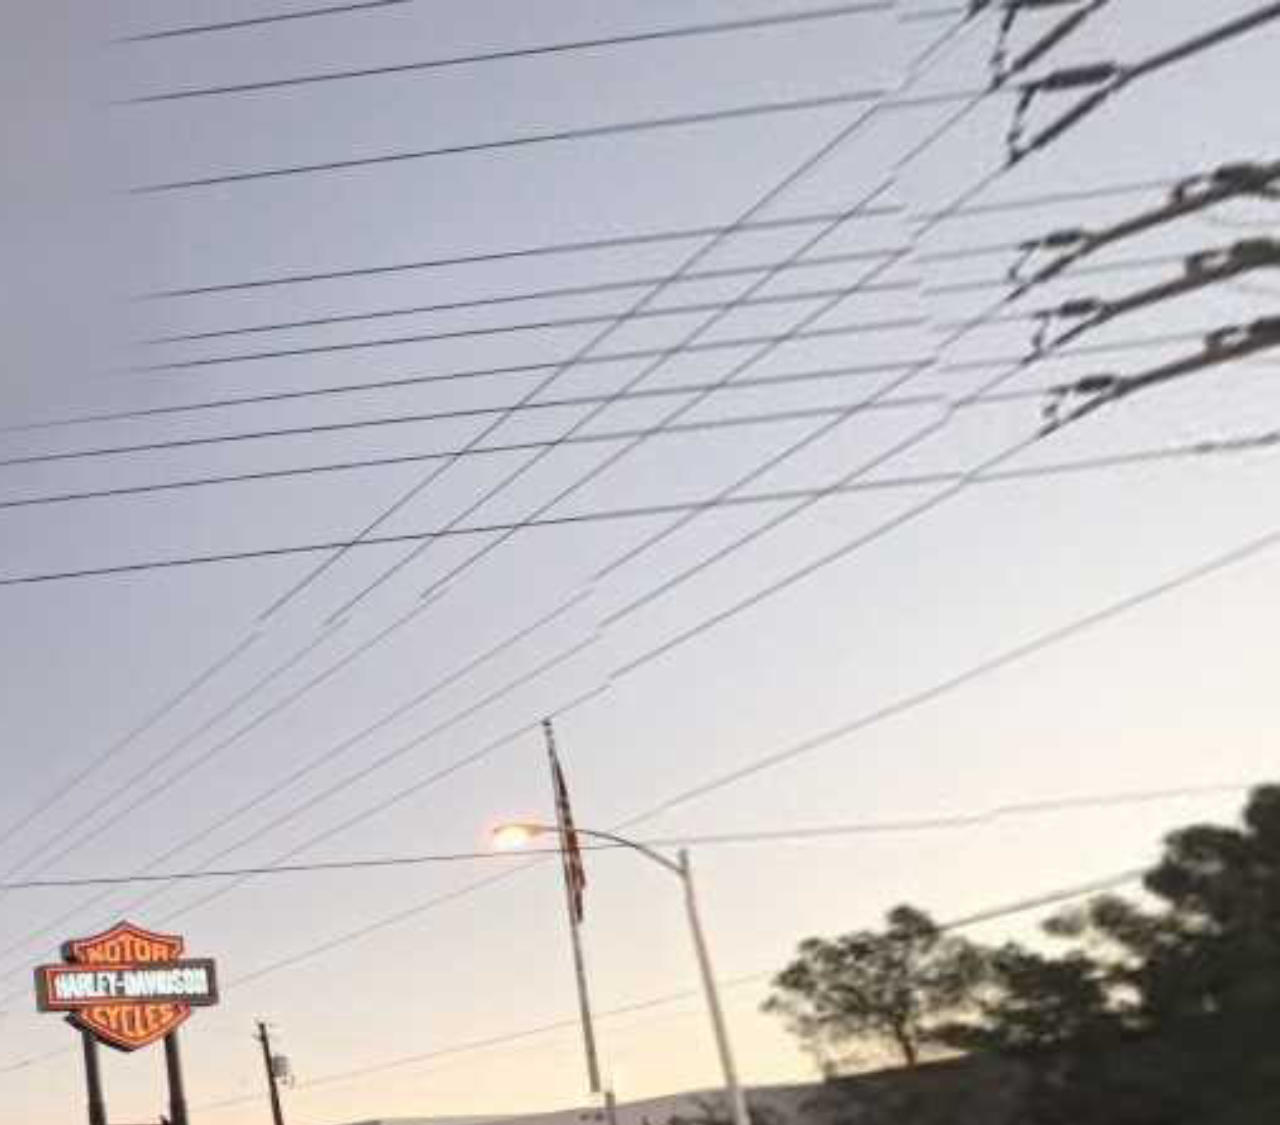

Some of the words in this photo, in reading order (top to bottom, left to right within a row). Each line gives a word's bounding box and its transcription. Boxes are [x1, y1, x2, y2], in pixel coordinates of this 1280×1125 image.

[85, 938, 172, 963] MOTOR
[54, 967, 209, 999] HARLEY-DAVIDSON
[92, 1002, 175, 1037] CYCLES
